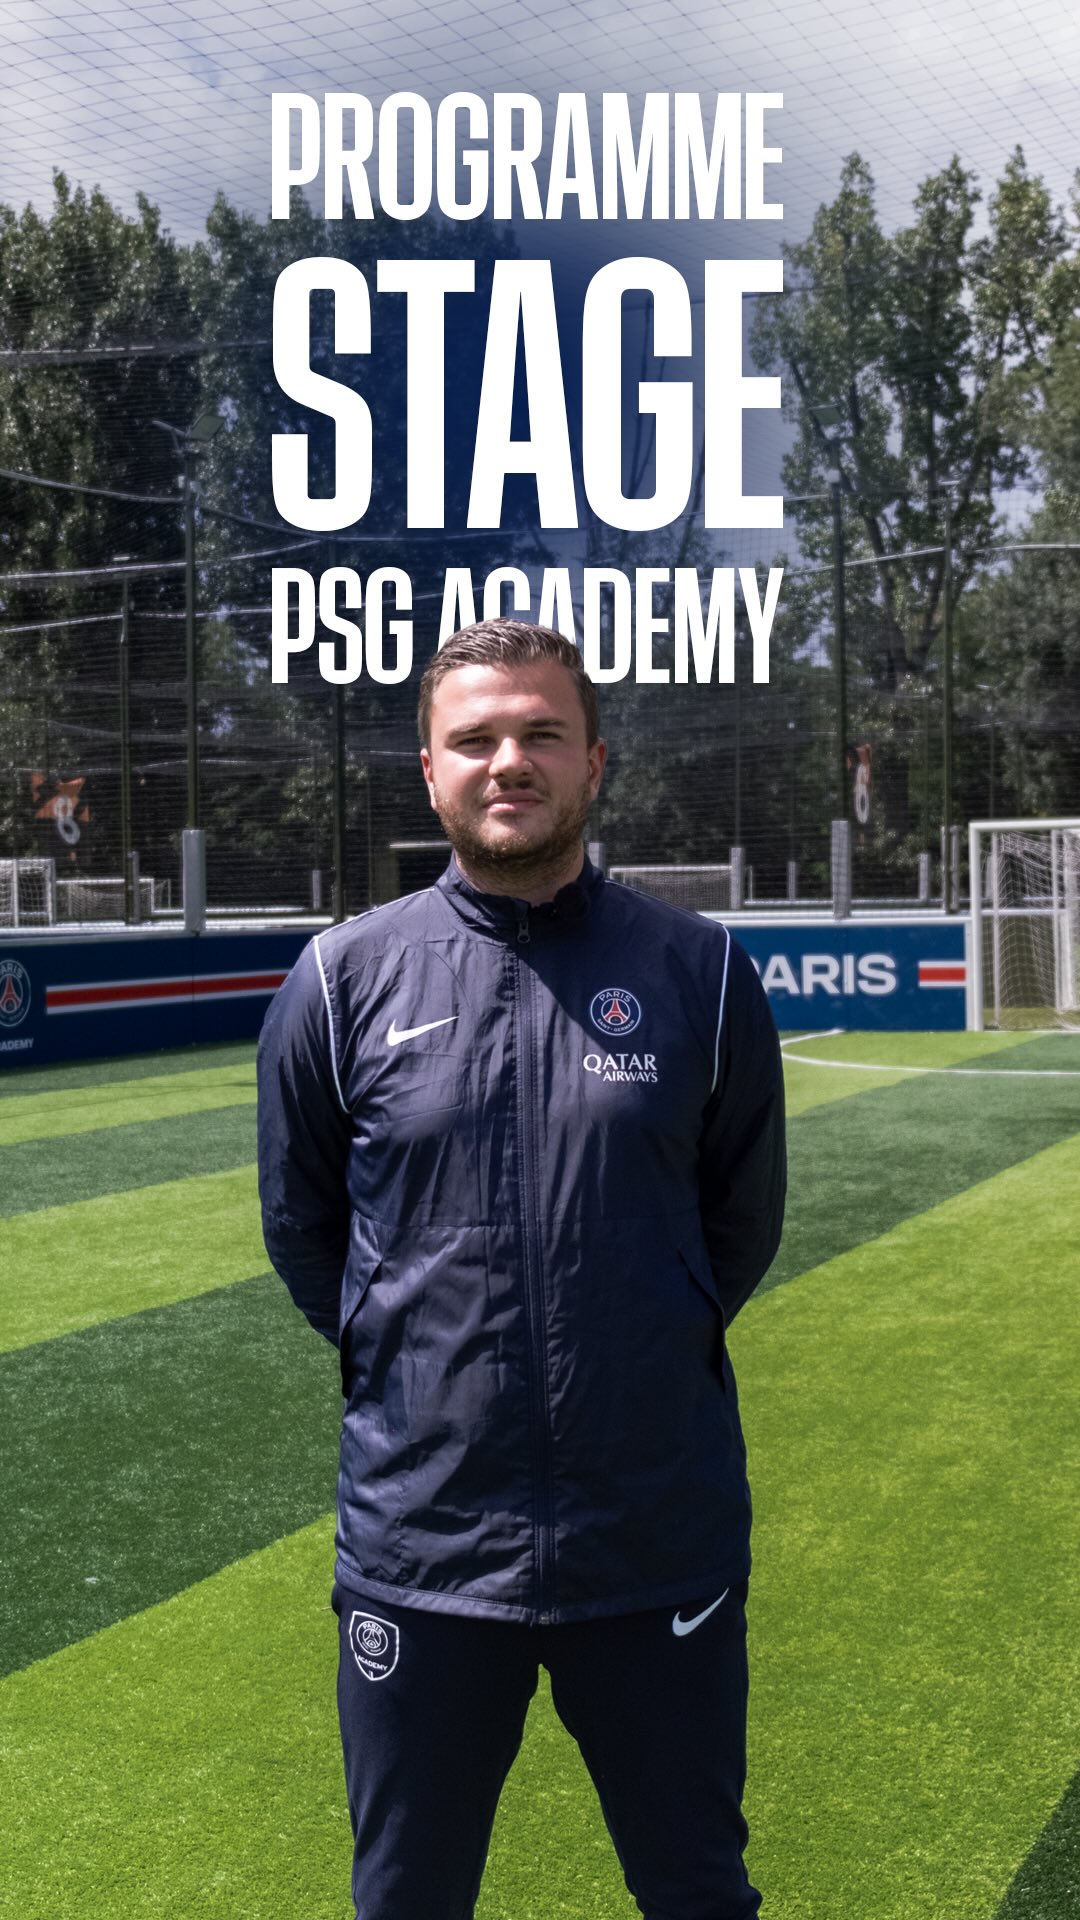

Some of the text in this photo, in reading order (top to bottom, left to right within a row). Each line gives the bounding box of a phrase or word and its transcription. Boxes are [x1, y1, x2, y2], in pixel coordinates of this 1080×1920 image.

[0, 963, 24, 978] ARIS
[750, 953, 897, 995] ARIS
[599, 990, 632, 1003] PARIS
[0, 1038, 34, 1051] ADEMY
[583, 1053, 657, 1074] QATAR
[603, 1071, 658, 1083] AIRWAYS
[363, 1622, 383, 1635] PARIS
[358, 1655, 388, 1671] ACADEMY
